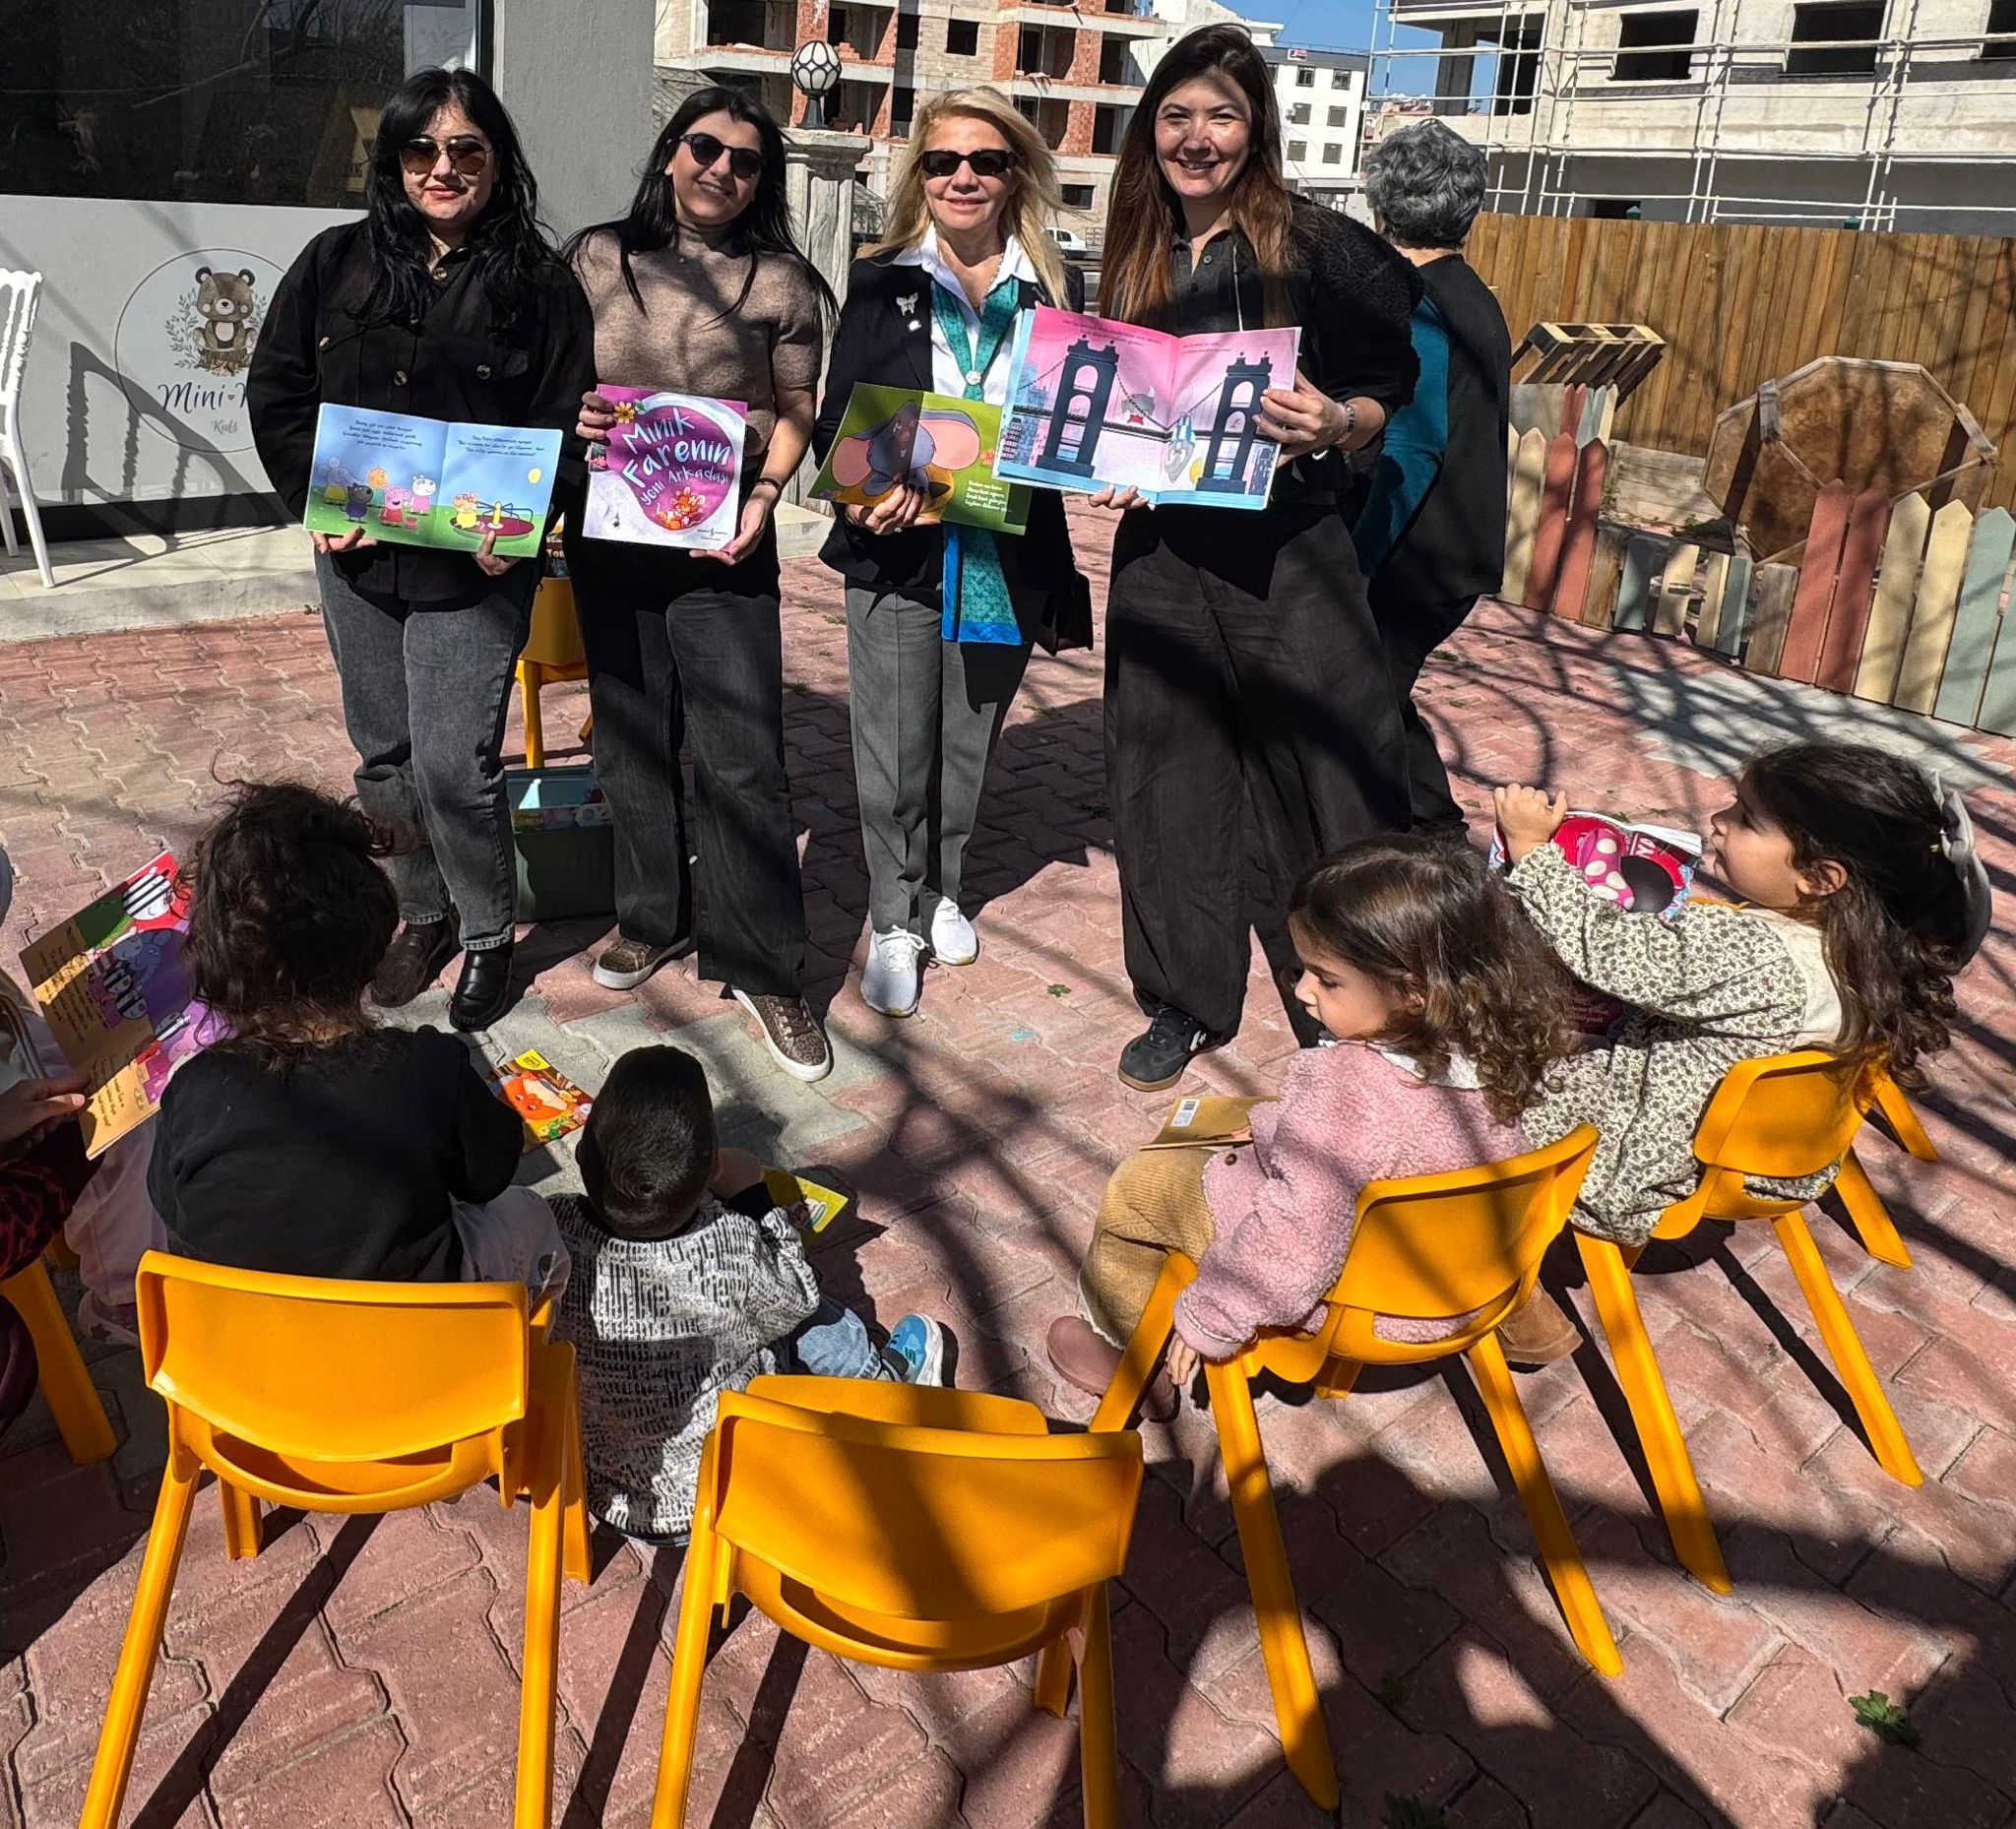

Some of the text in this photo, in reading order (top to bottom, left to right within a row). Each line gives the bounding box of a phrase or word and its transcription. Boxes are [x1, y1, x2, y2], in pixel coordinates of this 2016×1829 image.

[158, 381, 225, 413] Mini
[212, 418, 238, 434] Kids
[621, 407, 695, 455] Minik
[621, 439, 731, 488] Farenin
